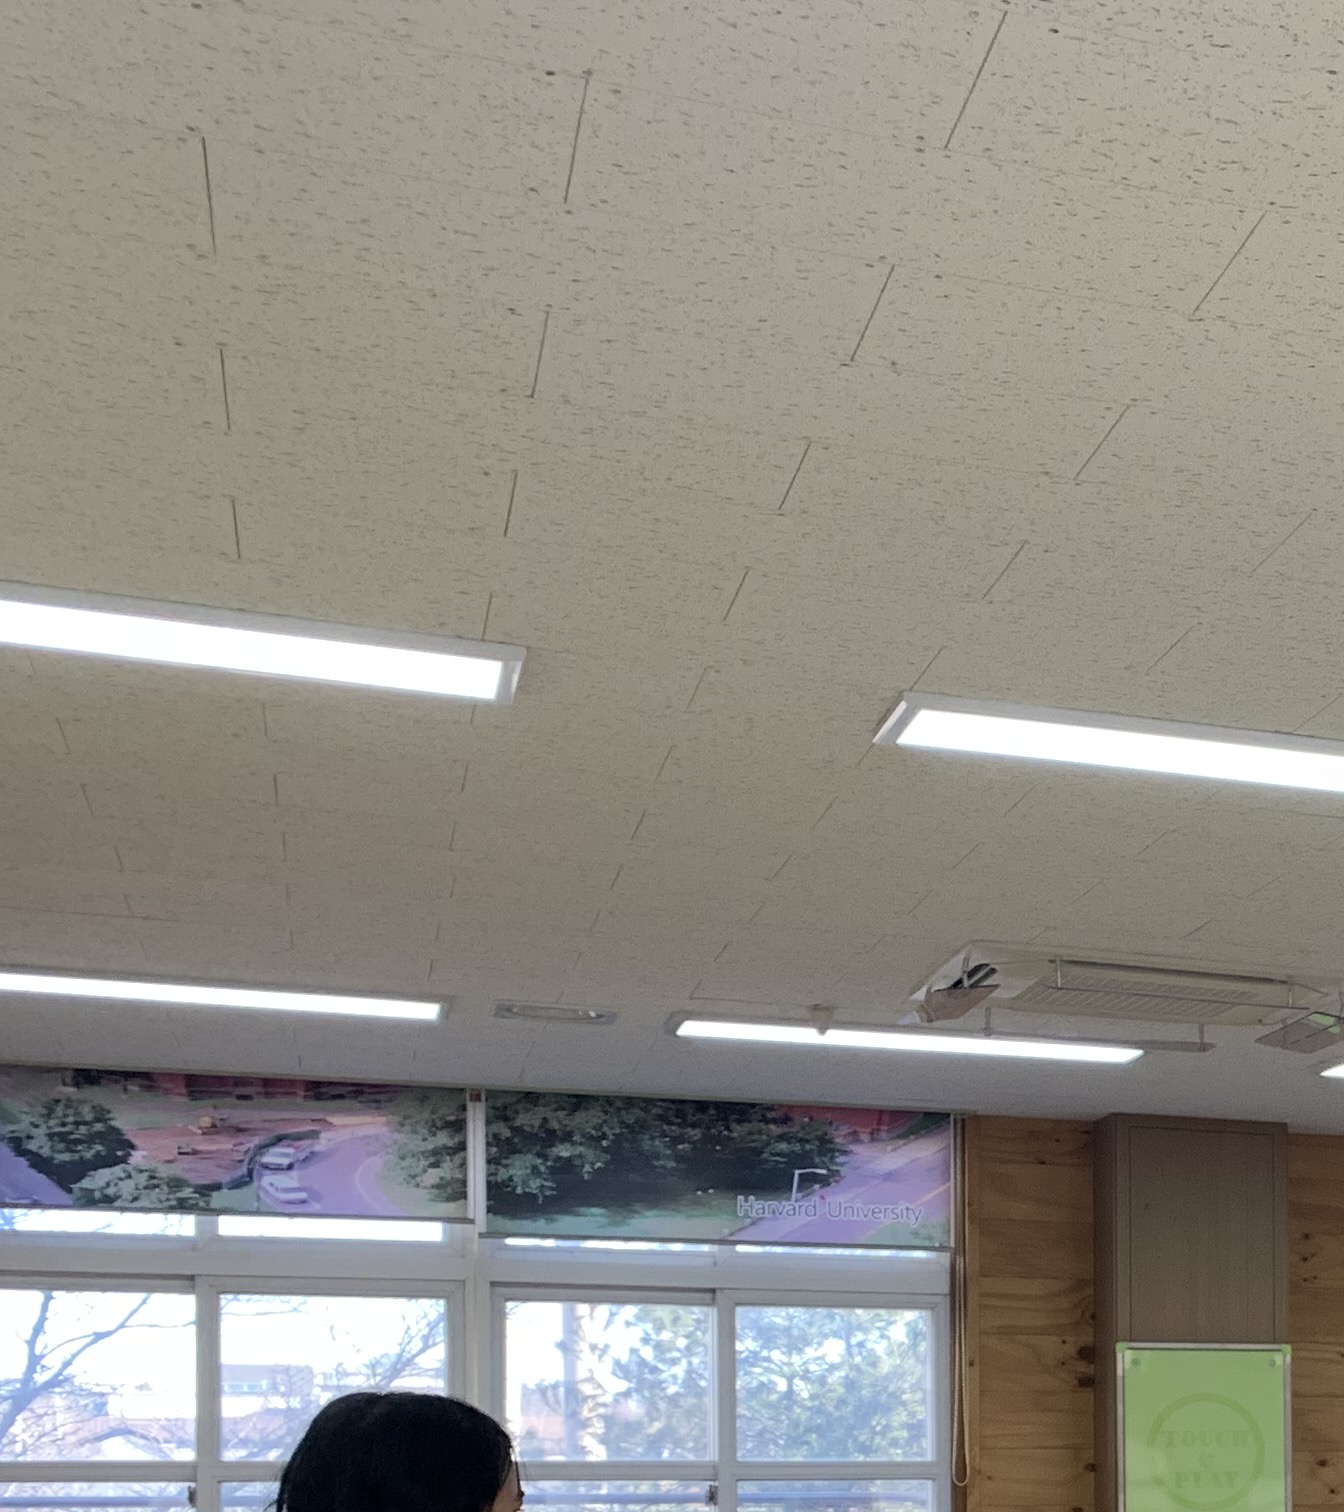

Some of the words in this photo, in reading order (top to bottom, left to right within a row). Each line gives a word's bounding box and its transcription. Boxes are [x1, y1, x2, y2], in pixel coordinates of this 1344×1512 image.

[738, 1196, 817, 1217] Harvard
[828, 1200, 922, 1227] University
[1161, 1430, 1250, 1448] TOUCH
